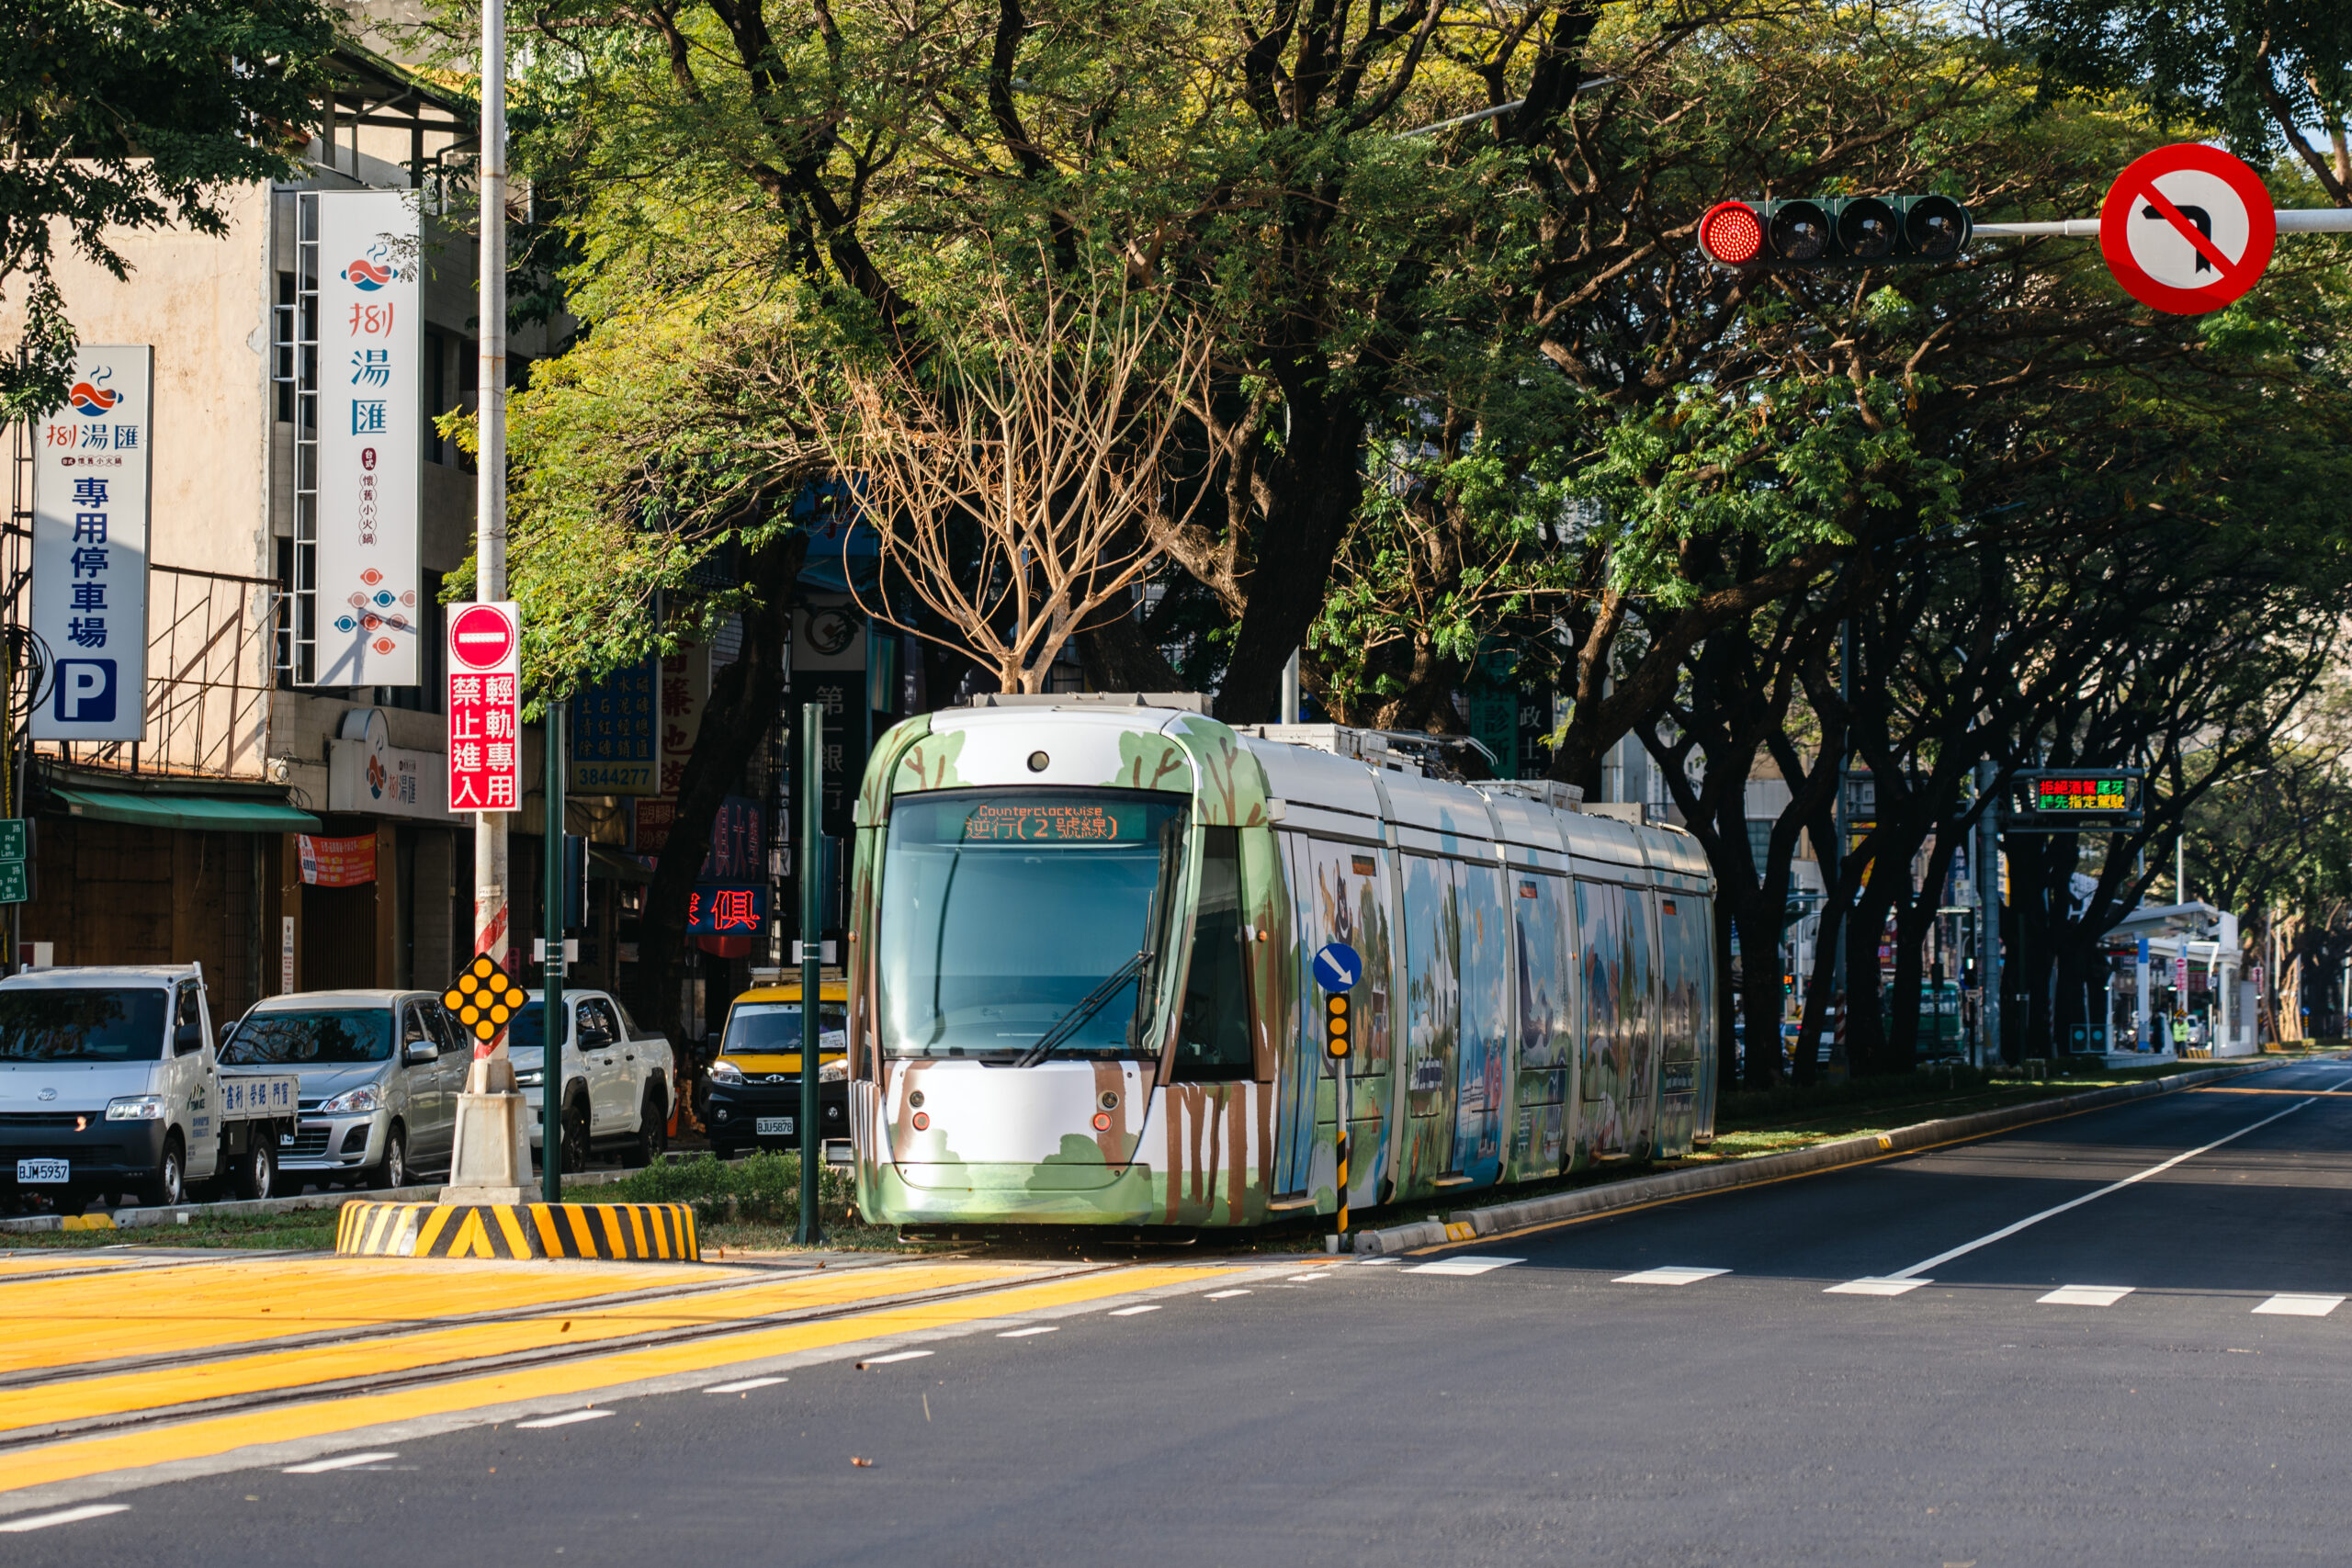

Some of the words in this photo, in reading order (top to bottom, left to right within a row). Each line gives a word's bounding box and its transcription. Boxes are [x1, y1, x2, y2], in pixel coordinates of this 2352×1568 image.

[362, 476, 374, 545] 懷舊小火鍋
[68, 477, 109, 649] 專用停車場
[64, 663, 106, 717] P
[616, 676, 632, 759] 水泥經銷
[453, 676, 481, 806] 禁止進入
[485, 676, 514, 806] 輕軌專用
[580, 768, 650, 786] 3844277
[979, 806, 1102, 817] Counterclockwise
[2040, 795, 2125, 809] 請先指定駕駛
